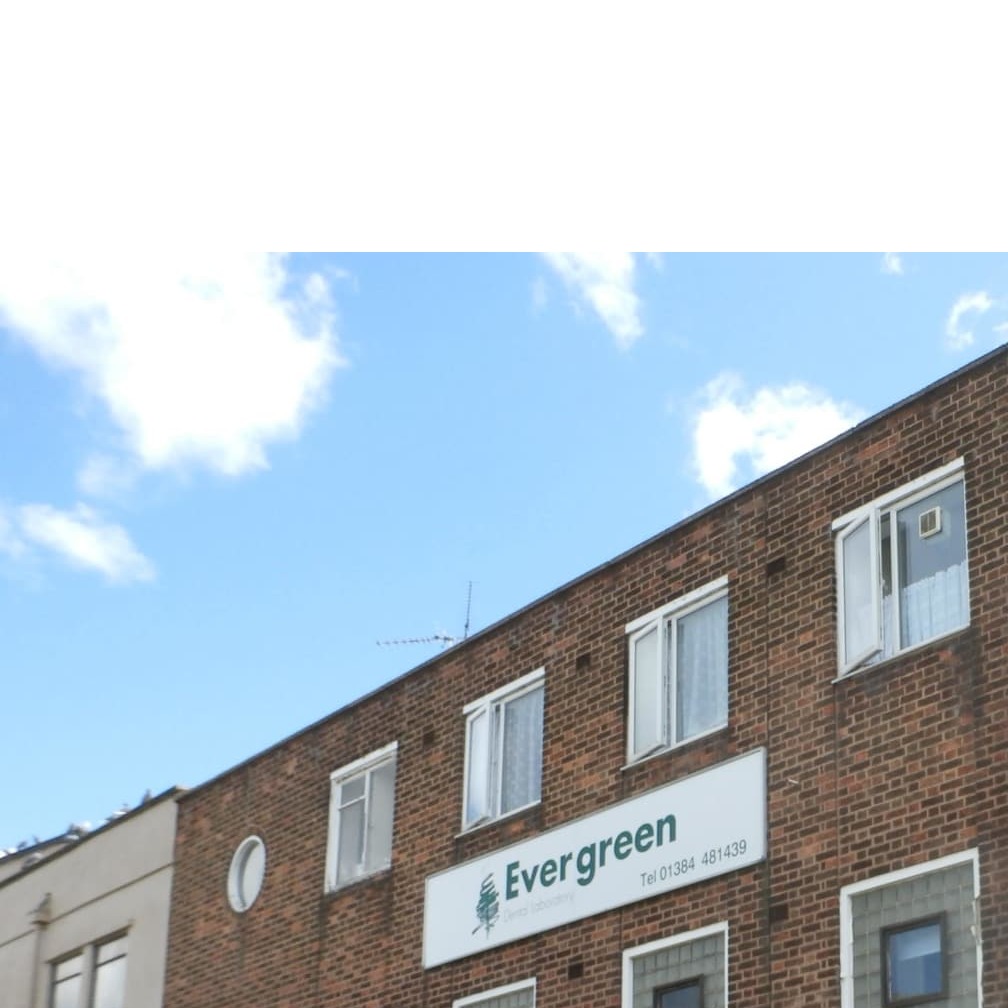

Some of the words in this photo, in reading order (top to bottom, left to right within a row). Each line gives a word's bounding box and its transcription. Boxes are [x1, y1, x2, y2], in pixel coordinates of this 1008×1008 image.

[505, 813, 678, 901] Evergreen
[640, 871, 657, 887] Tel
[660, 857, 696, 881] 01384
[701, 839, 748, 866] 481439
